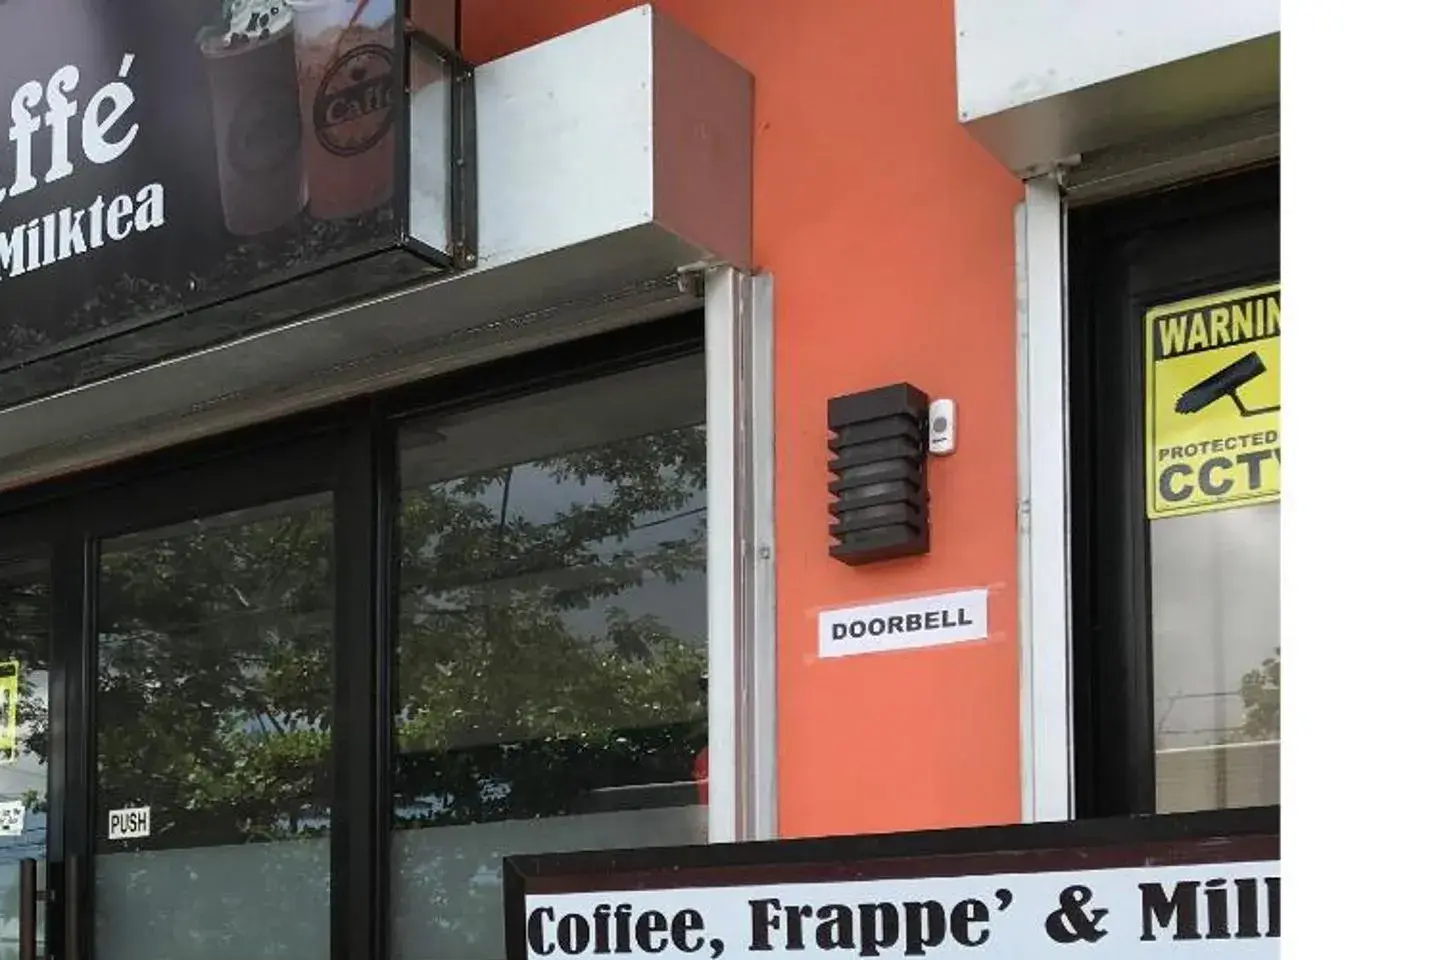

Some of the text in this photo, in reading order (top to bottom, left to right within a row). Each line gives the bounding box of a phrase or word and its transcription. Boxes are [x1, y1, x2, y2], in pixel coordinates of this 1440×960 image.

[1159, 430, 1278, 461] PROTECTED
[1159, 449, 1280, 502] CCT
[832, 608, 972, 641] DOORBELL
[111, 812, 147, 834] PUSH
[527, 903, 725, 960] Coffee,
[1044, 884, 1110, 943] &
